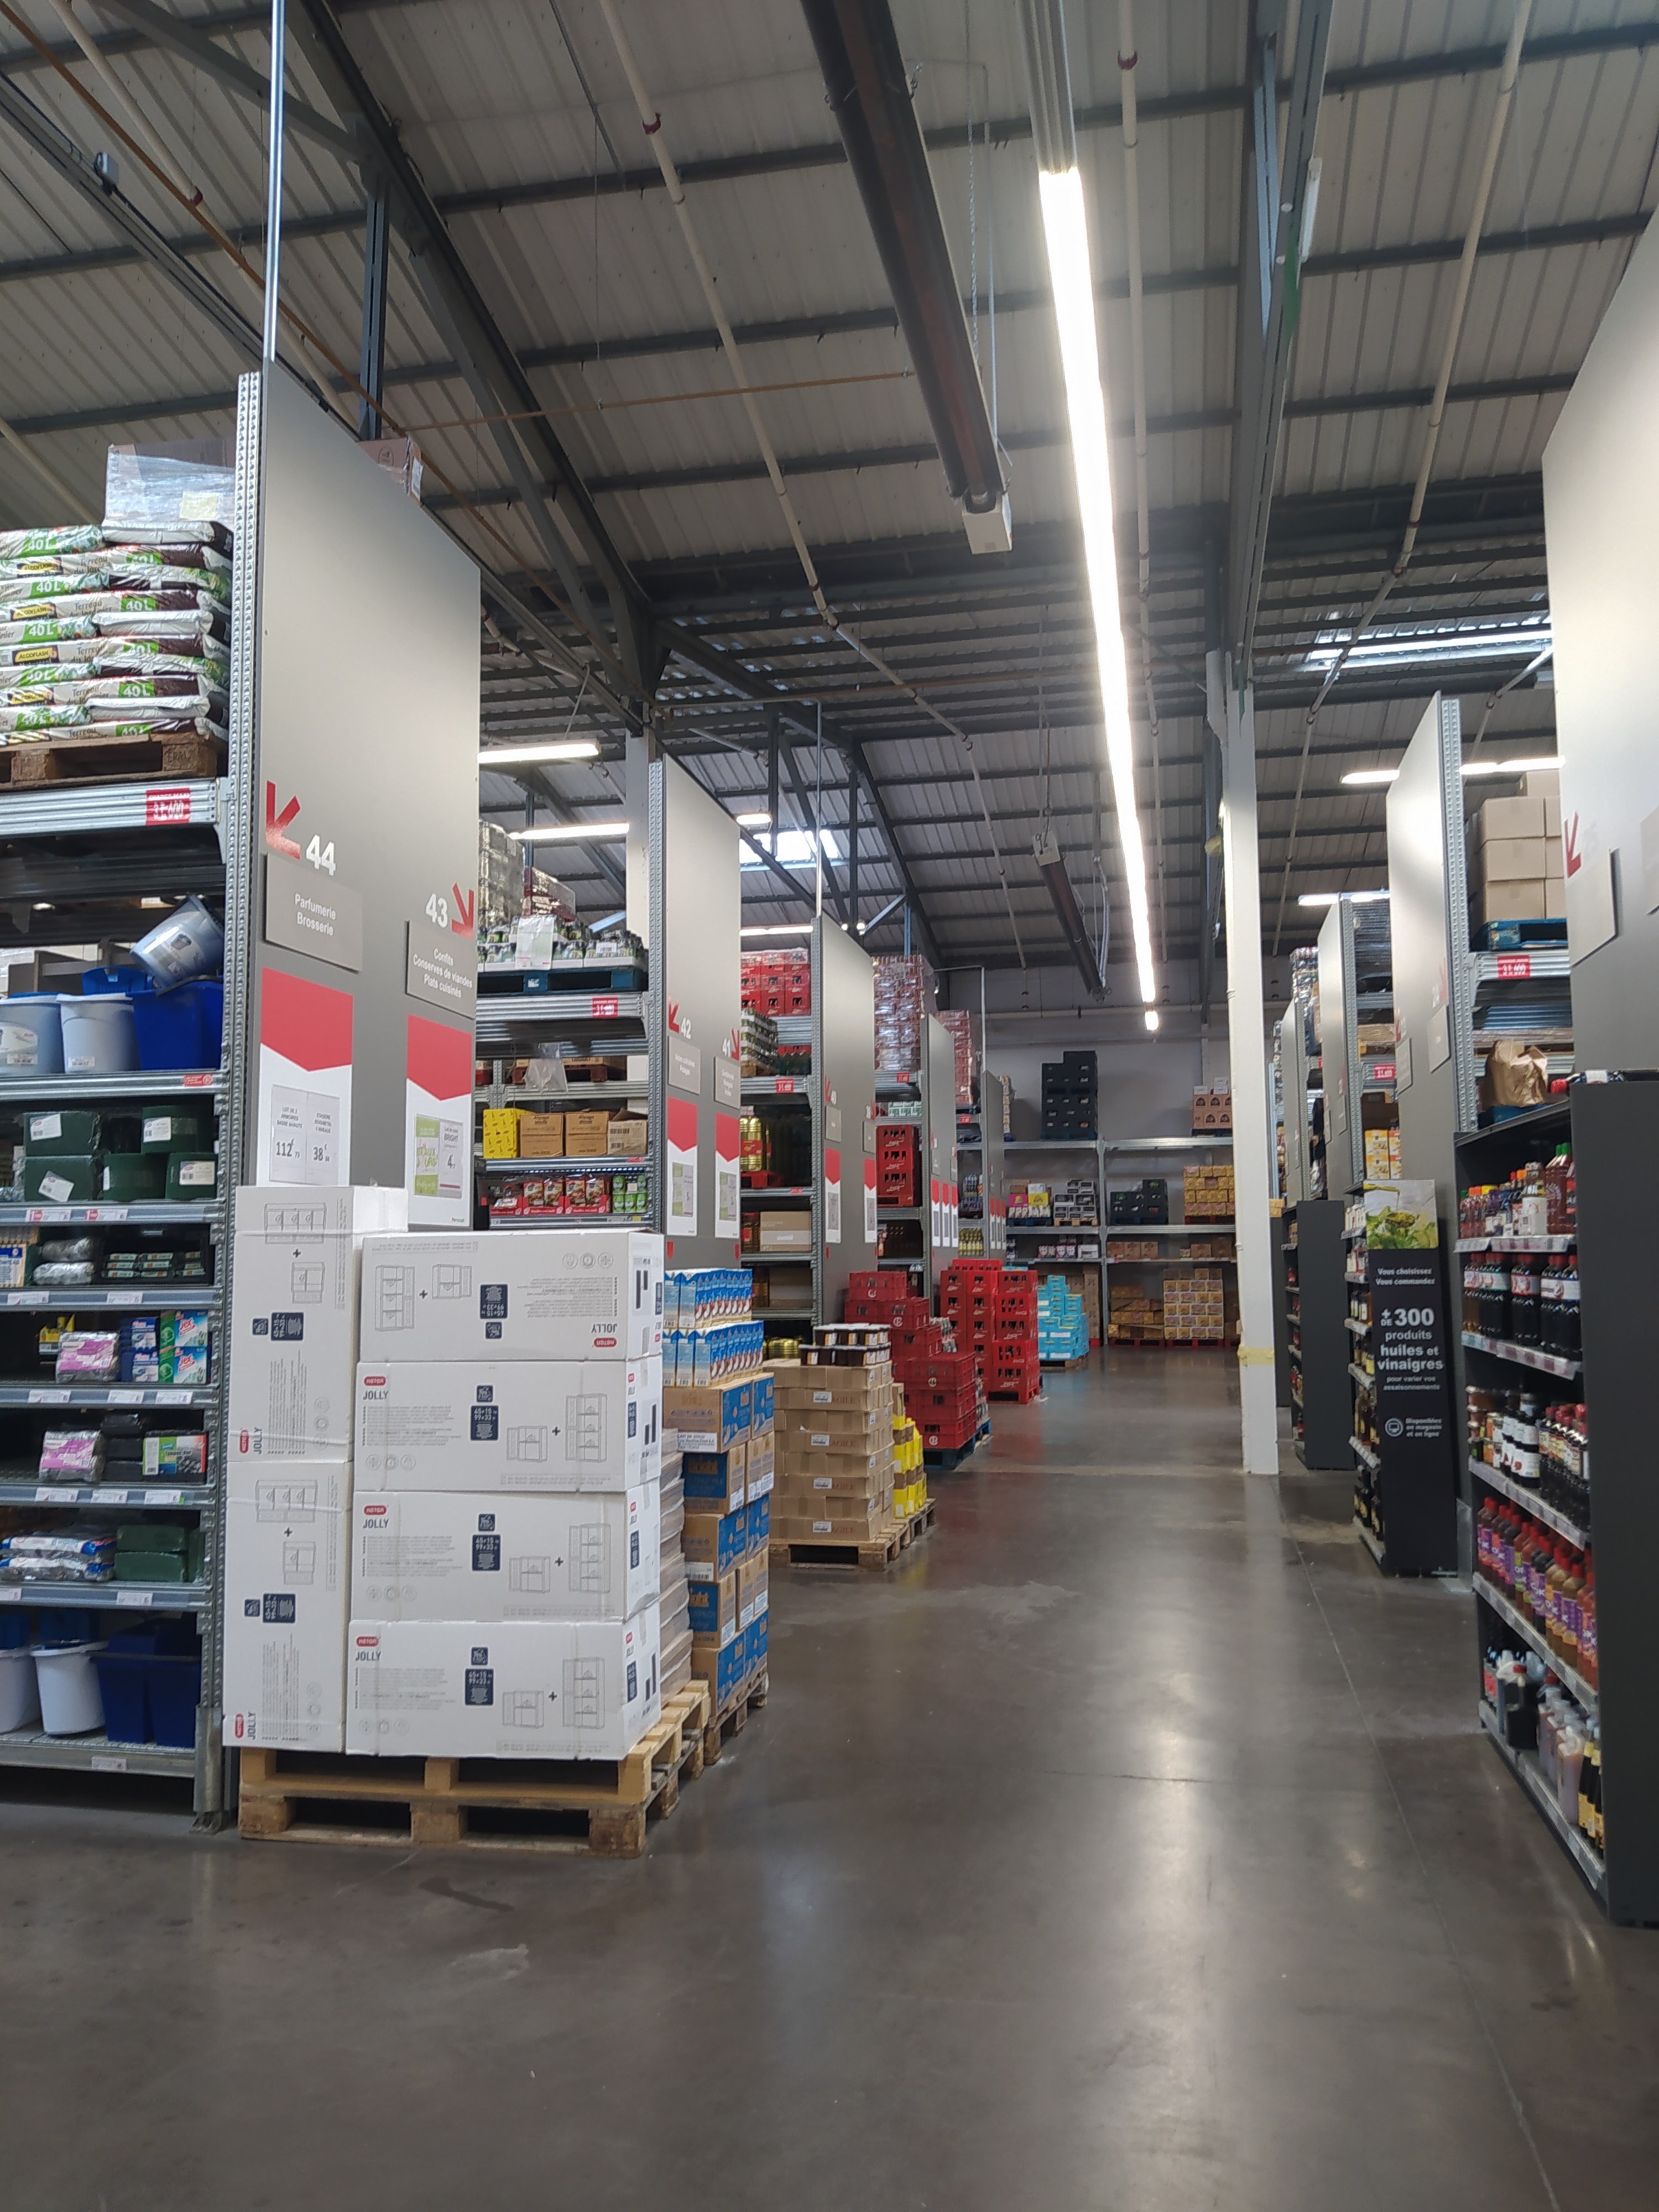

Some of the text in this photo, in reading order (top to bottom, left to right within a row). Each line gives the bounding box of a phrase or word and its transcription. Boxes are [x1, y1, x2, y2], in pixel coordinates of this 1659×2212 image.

[18, 651, 49, 660] ALGOFLASH
[306, 834, 336, 876] 44
[295, 893, 336, 920] Parfumerie
[425, 893, 448, 928] 43
[296, 911, 333, 936] Brosserie
[434, 948, 454, 966] Confits
[413, 953, 473, 989] Conserves de viandes
[424, 973, 462, 998] Plats cuisinés
[681, 1017, 691, 1040] 42
[722, 1037, 731, 1057] 41
[276, 1141, 293, 1157] 112
[313, 1146, 324, 1161] 38
[180, 1318, 192, 1331] jex
[1394, 1308, 1434, 1326] 300
[591, 1323, 618, 1333] JOLLY
[1385, 1329, 1433, 1343] produits
[1380, 1343, 1439, 1357] huiles et
[179, 1354, 191, 1366] jex
[1377, 1358, 1444, 1373] vinaigres
[363, 1390, 389, 1400] JOLLY
[253, 1427, 262, 1455] JOLLY
[362, 1519, 389, 1528] JOLLY
[355, 1651, 382, 1661] JOLLY
[247, 1711, 256, 1740] JOLLY
